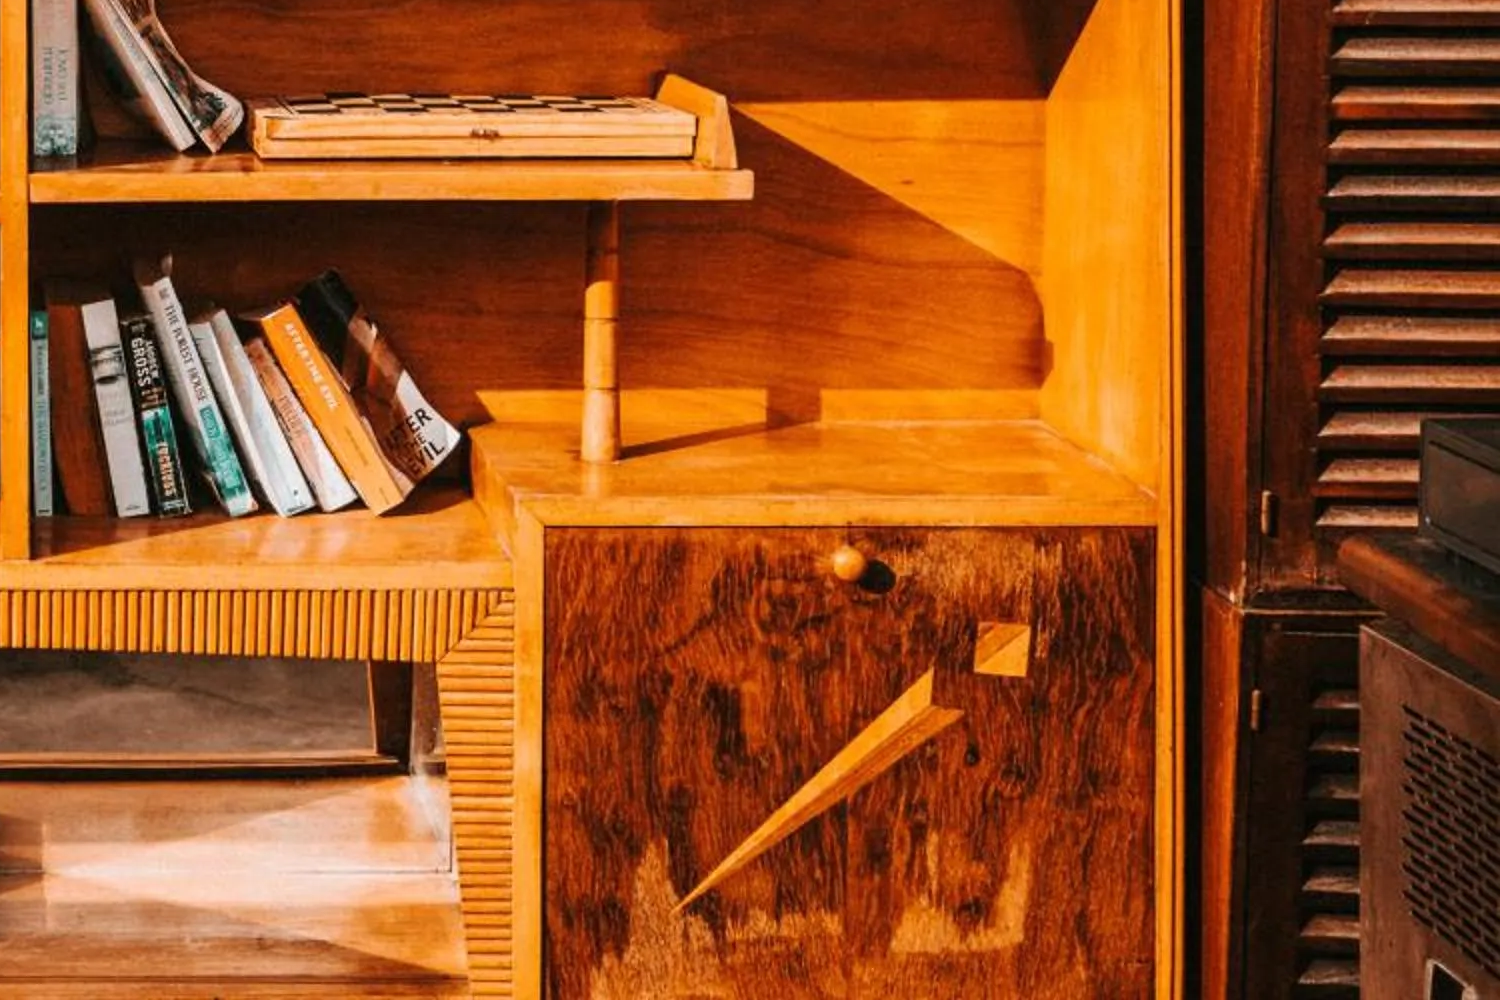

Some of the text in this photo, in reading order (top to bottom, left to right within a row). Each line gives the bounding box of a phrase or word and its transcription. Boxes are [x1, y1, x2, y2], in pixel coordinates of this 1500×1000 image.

[163, 303, 180, 326] THE
[129, 336, 151, 387] GROSS
[171, 325, 194, 366] FOREST
[303, 357, 325, 384] THE
